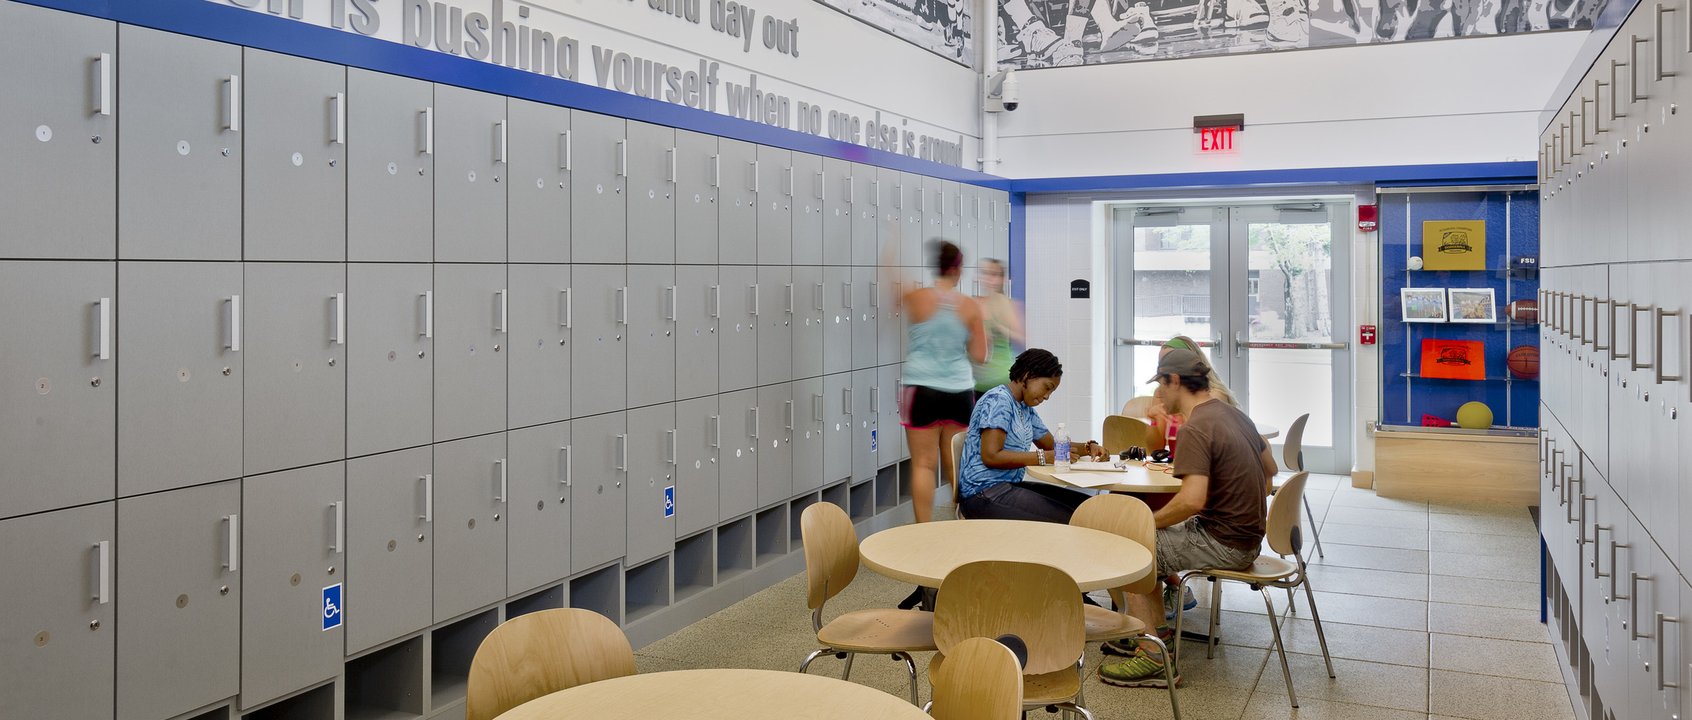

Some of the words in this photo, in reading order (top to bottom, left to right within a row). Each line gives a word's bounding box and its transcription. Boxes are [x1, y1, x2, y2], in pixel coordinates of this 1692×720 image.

[709, 0, 755, 53] day
[762, 15, 799, 58] out
[402, 0, 579, 83] pushing
[591, 44, 719, 112] yourself
[726, 74, 790, 128] when
[798, 100, 822, 135] no
[827, 109, 860, 144] one
[866, 111, 898, 153] else
[902, 118, 915, 157] is
[919, 135, 963, 168] around
[1201, 127, 1235, 150] EXIT
